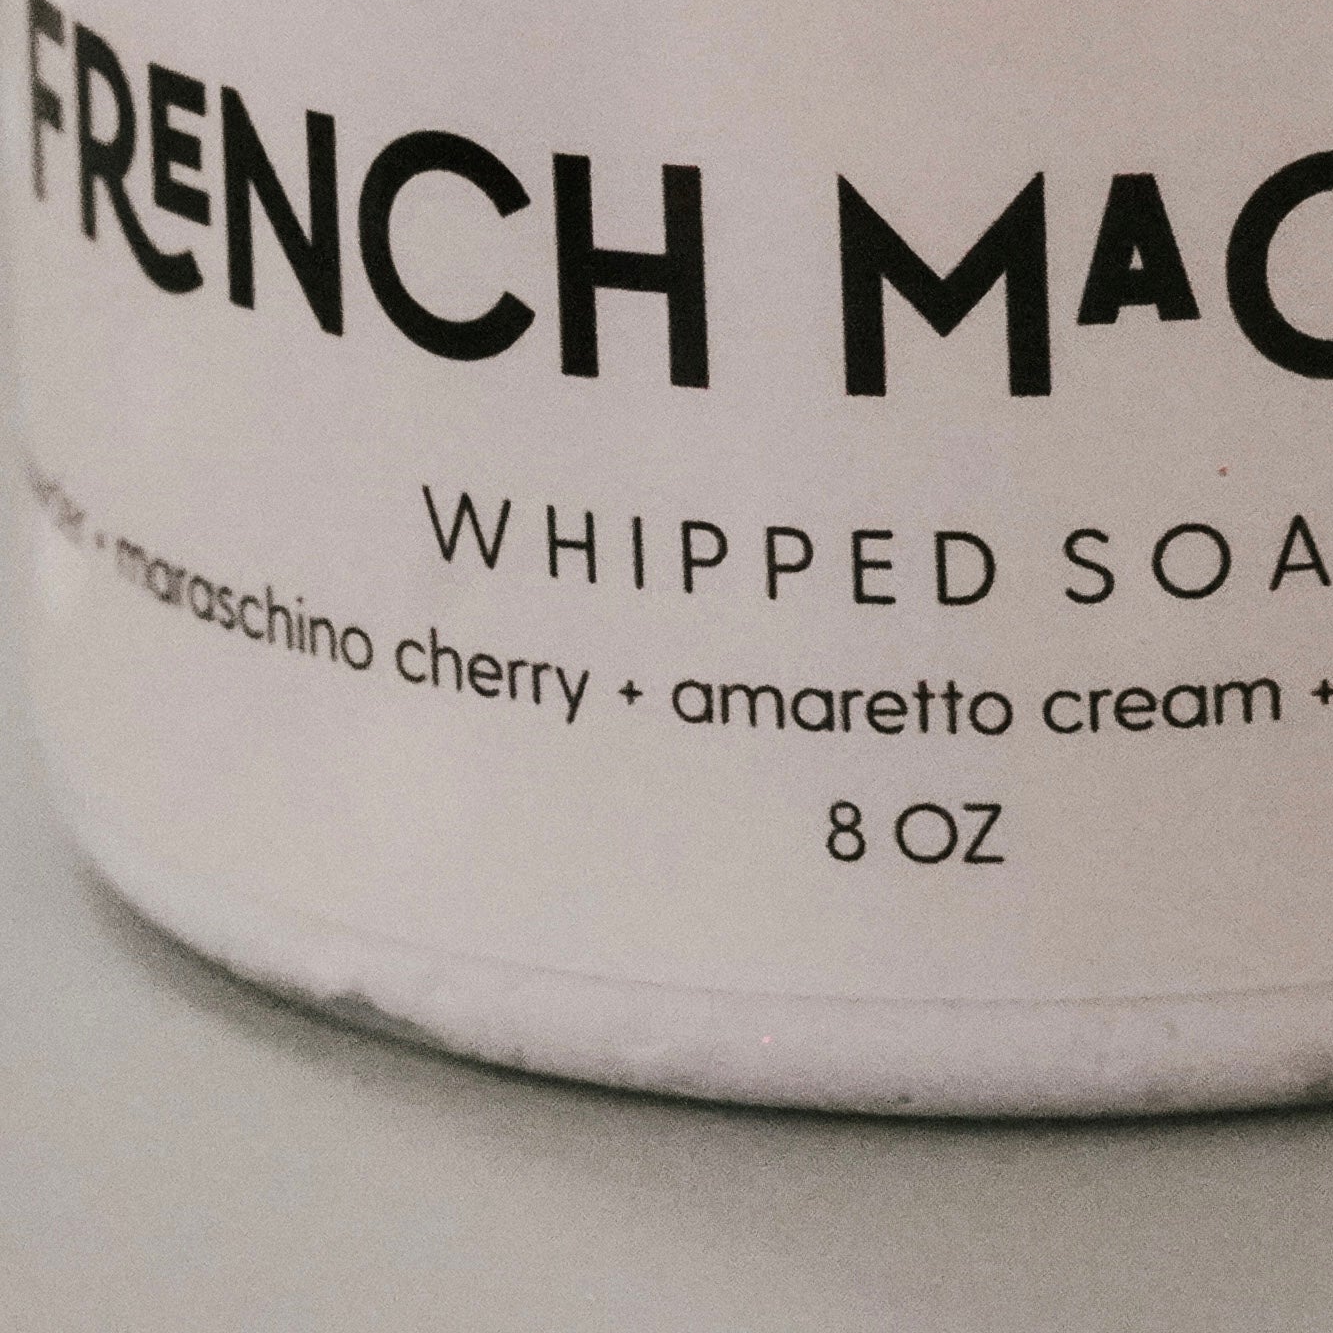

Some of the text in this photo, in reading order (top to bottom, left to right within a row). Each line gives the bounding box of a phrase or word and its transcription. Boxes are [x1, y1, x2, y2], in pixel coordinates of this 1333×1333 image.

[422, 485, 997, 607] WHIPPED
[394, 627, 590, 725] cherry
[671, 679, 1014, 736] amaretto
[1042, 677, 1282, 735] cream
[825, 799, 1005, 865] 8 OZ
